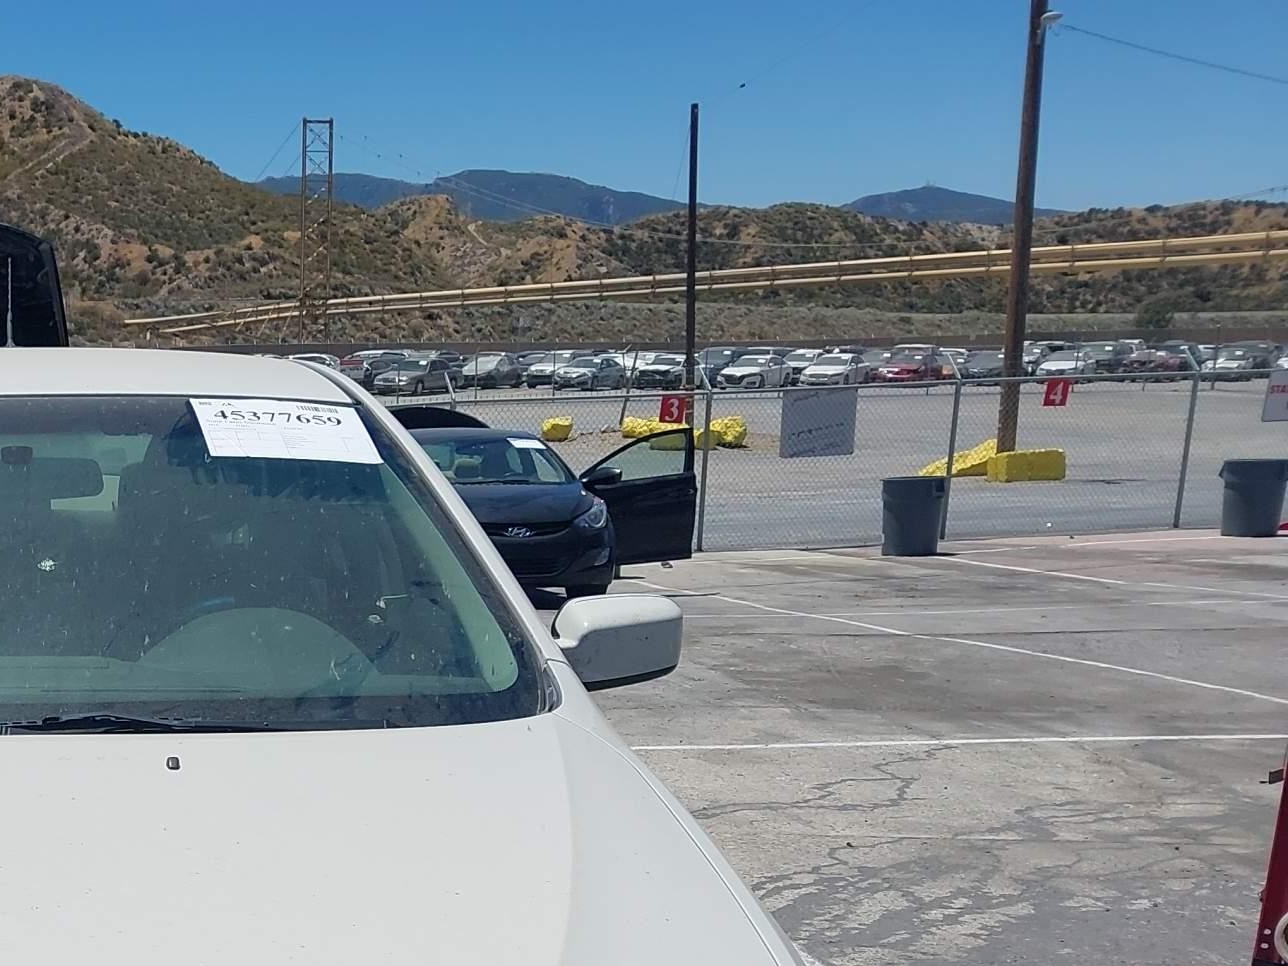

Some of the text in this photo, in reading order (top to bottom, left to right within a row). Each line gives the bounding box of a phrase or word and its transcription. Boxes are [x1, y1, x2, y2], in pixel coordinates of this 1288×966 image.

[1049, 381, 1063, 404] 4
[213, 409, 342, 427] 45377659
[664, 398, 679, 421] 3
